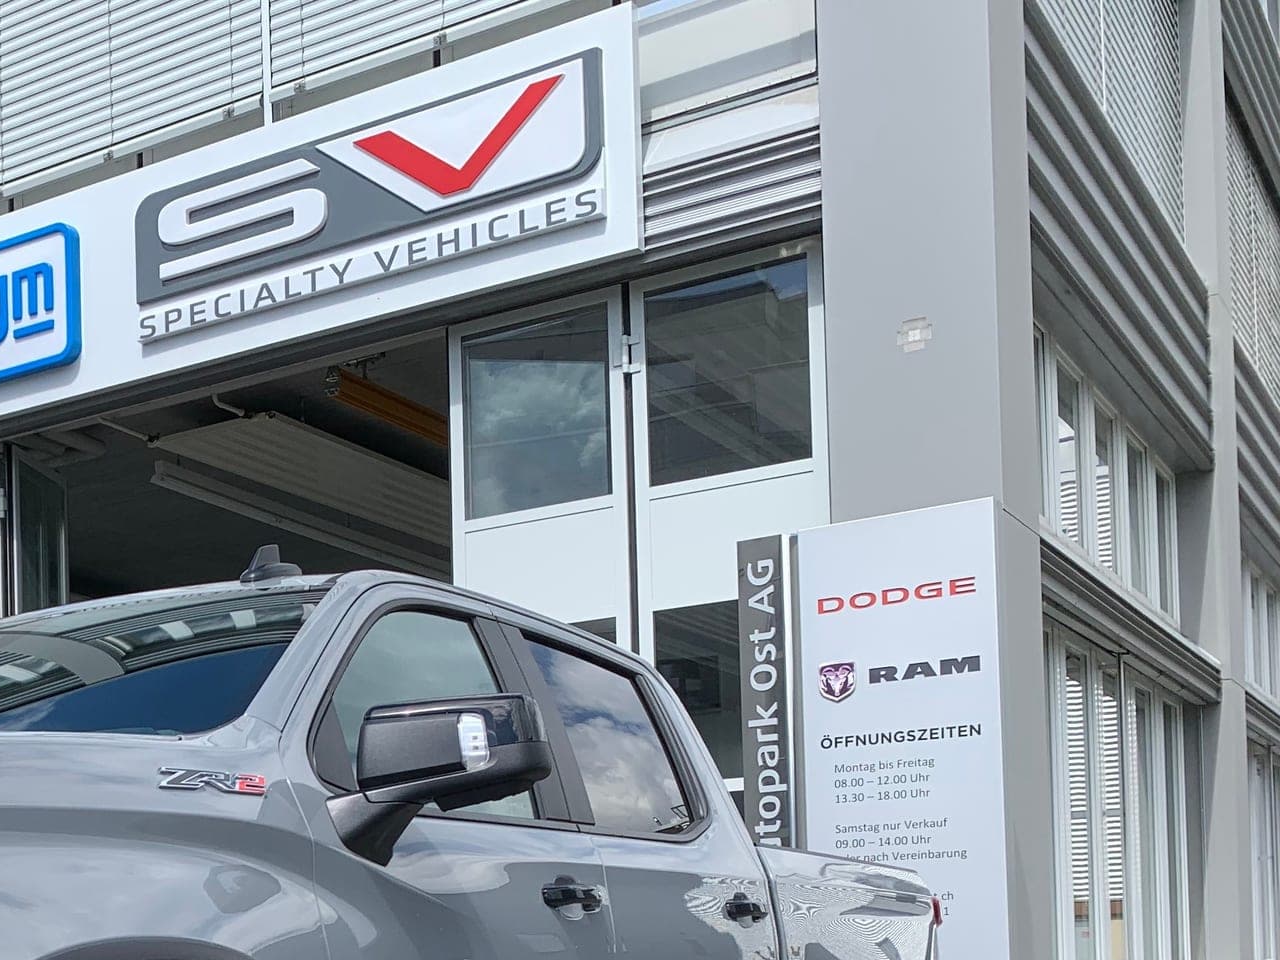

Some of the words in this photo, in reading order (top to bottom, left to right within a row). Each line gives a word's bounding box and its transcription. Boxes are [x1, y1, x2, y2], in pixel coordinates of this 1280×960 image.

[157, 73, 565, 288] SV
[139, 257, 353, 340] SPECIALTY
[373, 191, 599, 273] VEHICLES
[746, 558, 776, 615] AG
[817, 576, 977, 615] DODGE
[749, 626, 778, 692] Ost
[869, 655, 981, 685] RAM
[820, 723, 982, 750] ÖFFNUNGSZEITEN
[748, 701, 789, 847] topark
[834, 763, 876, 773] Montag
[878, 760, 894, 770] bis
[897, 758, 935, 768] Freitag
[834, 777, 864, 788] 08.00
[877, 774, 907, 786] 12.00
[910, 773, 930, 783] Uhr
[158, 766, 267, 796] ZR2
[835, 792, 865, 804] 13.30
[878, 789, 907, 801] 18.00
[910, 788, 931, 798] Uhr
[835, 823, 880, 834] Samstag
[882, 822, 902, 831] nur
[904, 817, 949, 829] Verkauf
[835, 838, 865, 849] 09.00
[878, 836, 908, 847] 14.00
[911, 835, 932, 845] Uhr
[892, 849, 968, 862] Vereinbarung
